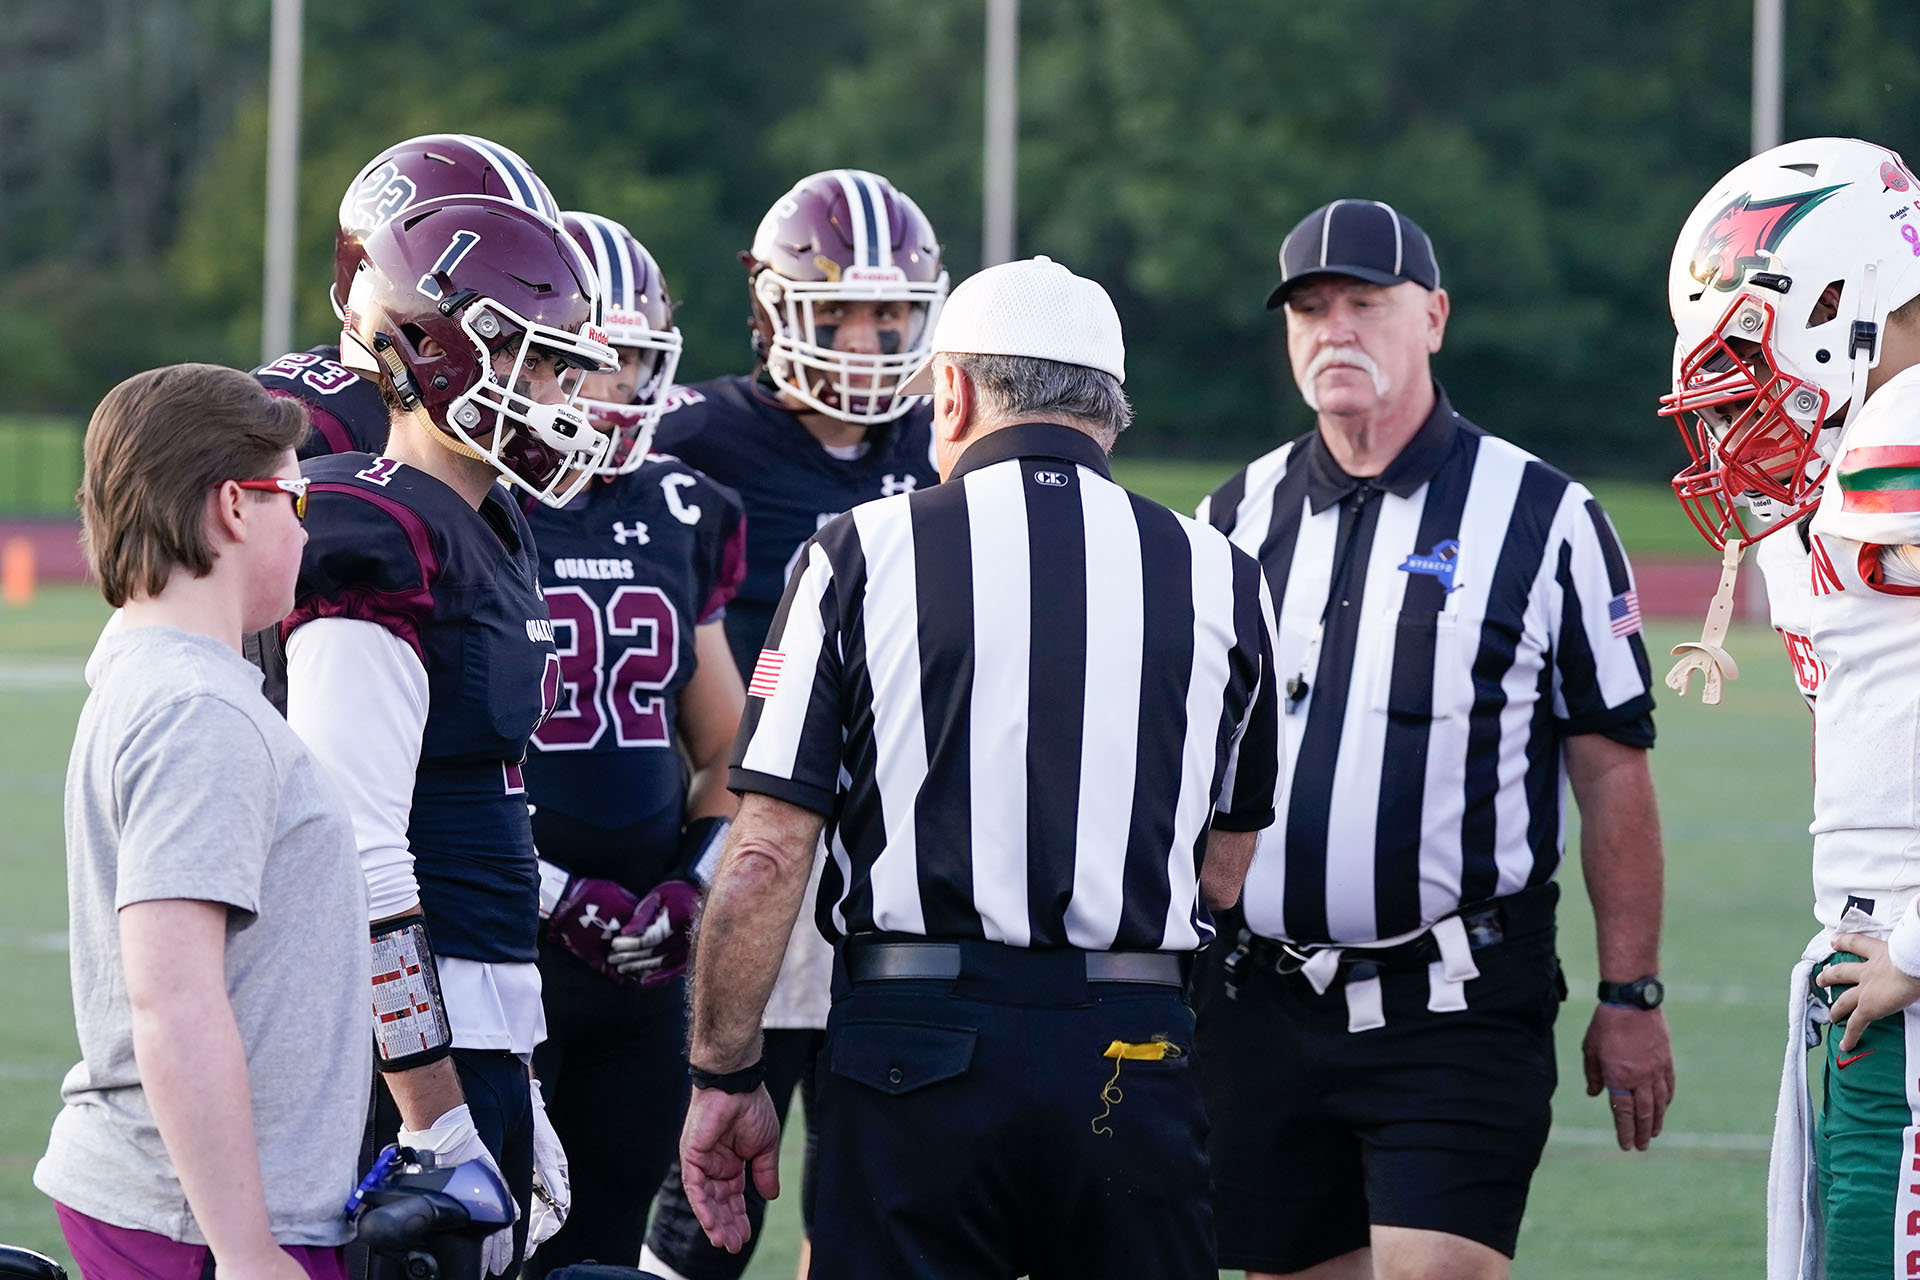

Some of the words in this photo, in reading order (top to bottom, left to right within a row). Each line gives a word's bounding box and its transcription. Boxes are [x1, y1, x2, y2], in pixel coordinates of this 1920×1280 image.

[416, 229, 481, 301] 1
[588, 327, 609, 346] Ridde
[257, 352, 360, 396] 23
[557, 408, 583, 425] SHOCK
[354, 456, 404, 487] 1
[660, 472, 701, 525] C
[554, 558, 635, 580] QUAKERS
